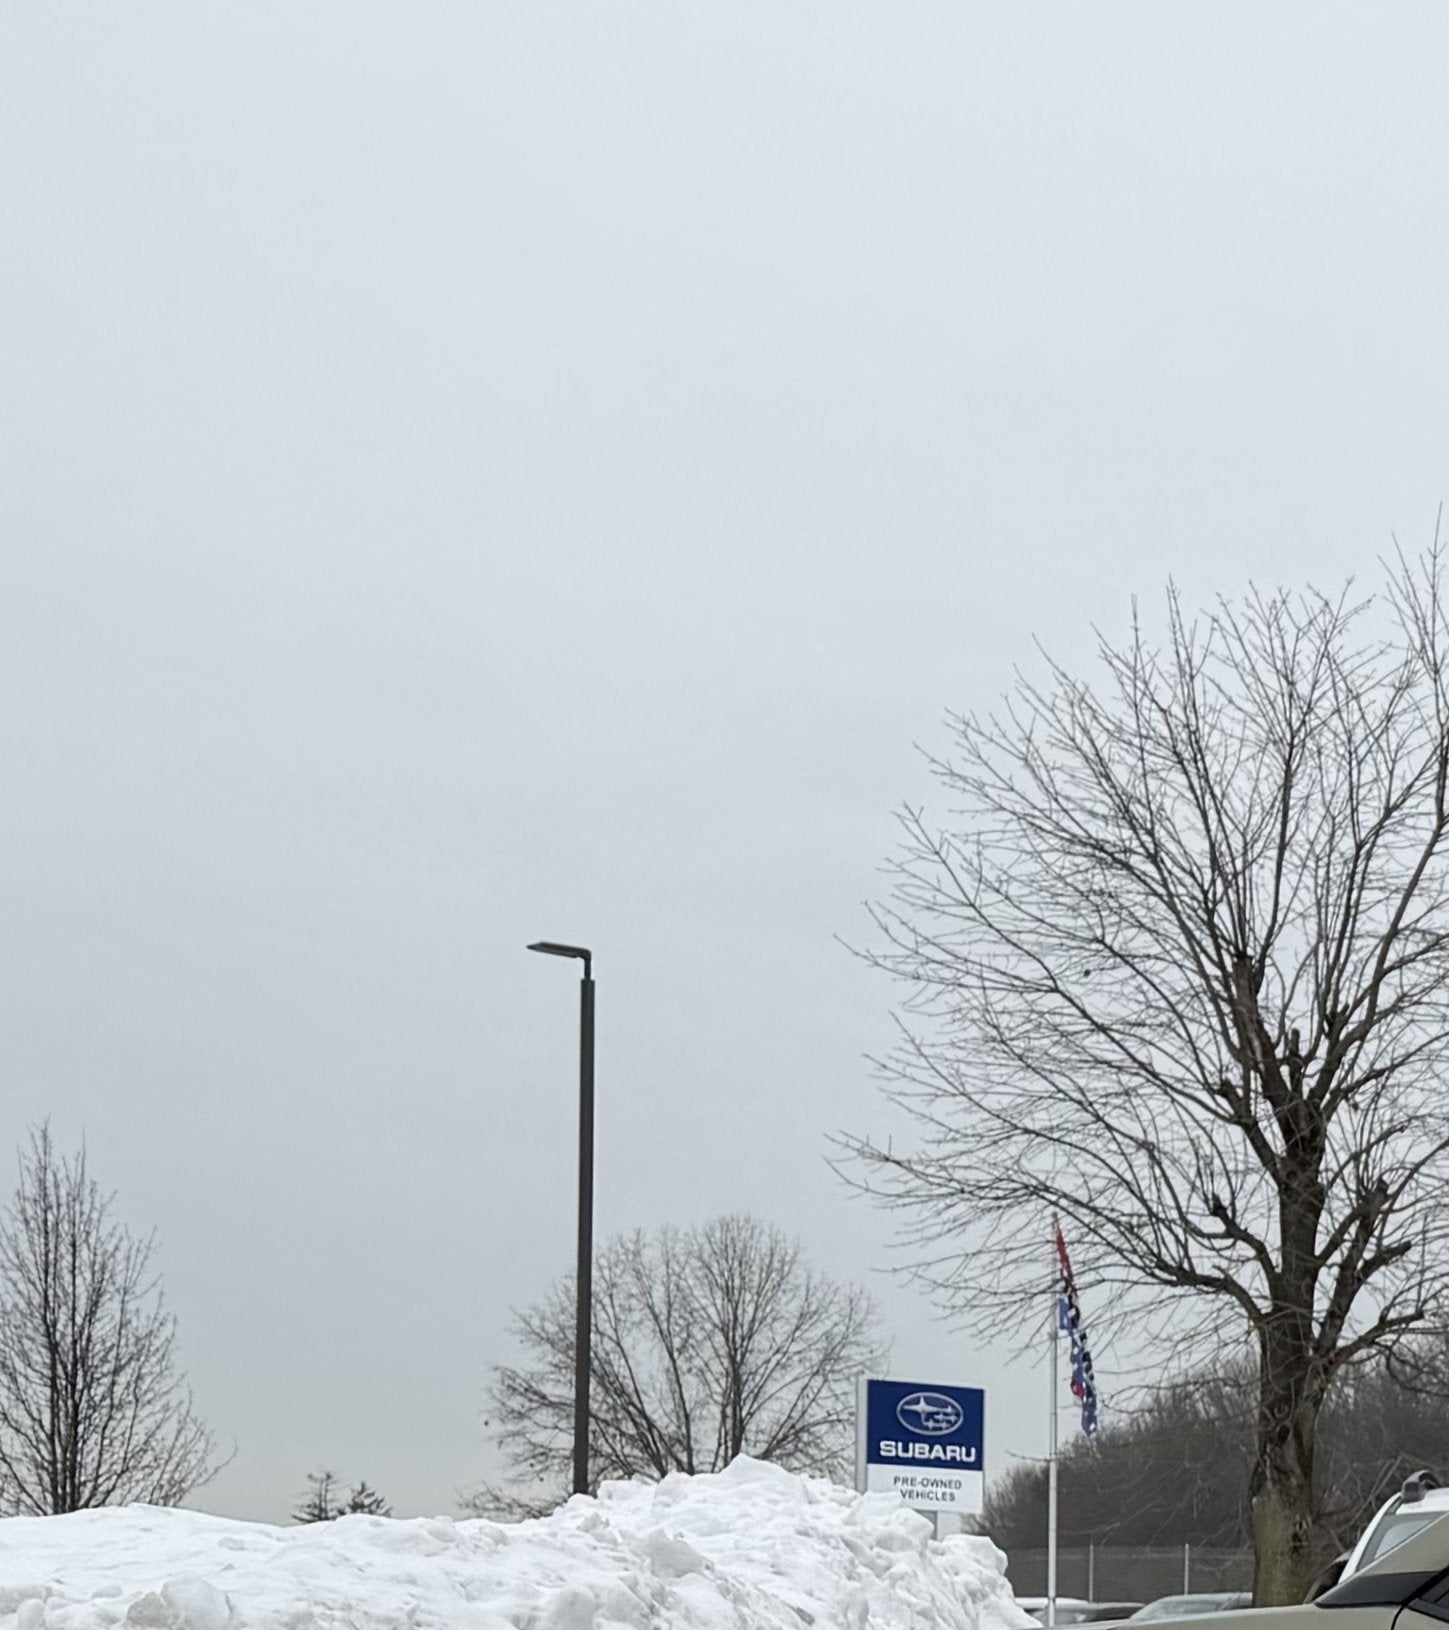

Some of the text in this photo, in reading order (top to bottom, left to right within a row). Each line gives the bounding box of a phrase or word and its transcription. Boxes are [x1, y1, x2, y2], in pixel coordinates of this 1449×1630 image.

[879, 1440, 976, 1462] SUBARU
[893, 1475, 962, 1490] PRE-OWNED
[900, 1489, 956, 1501] VEHICLES
